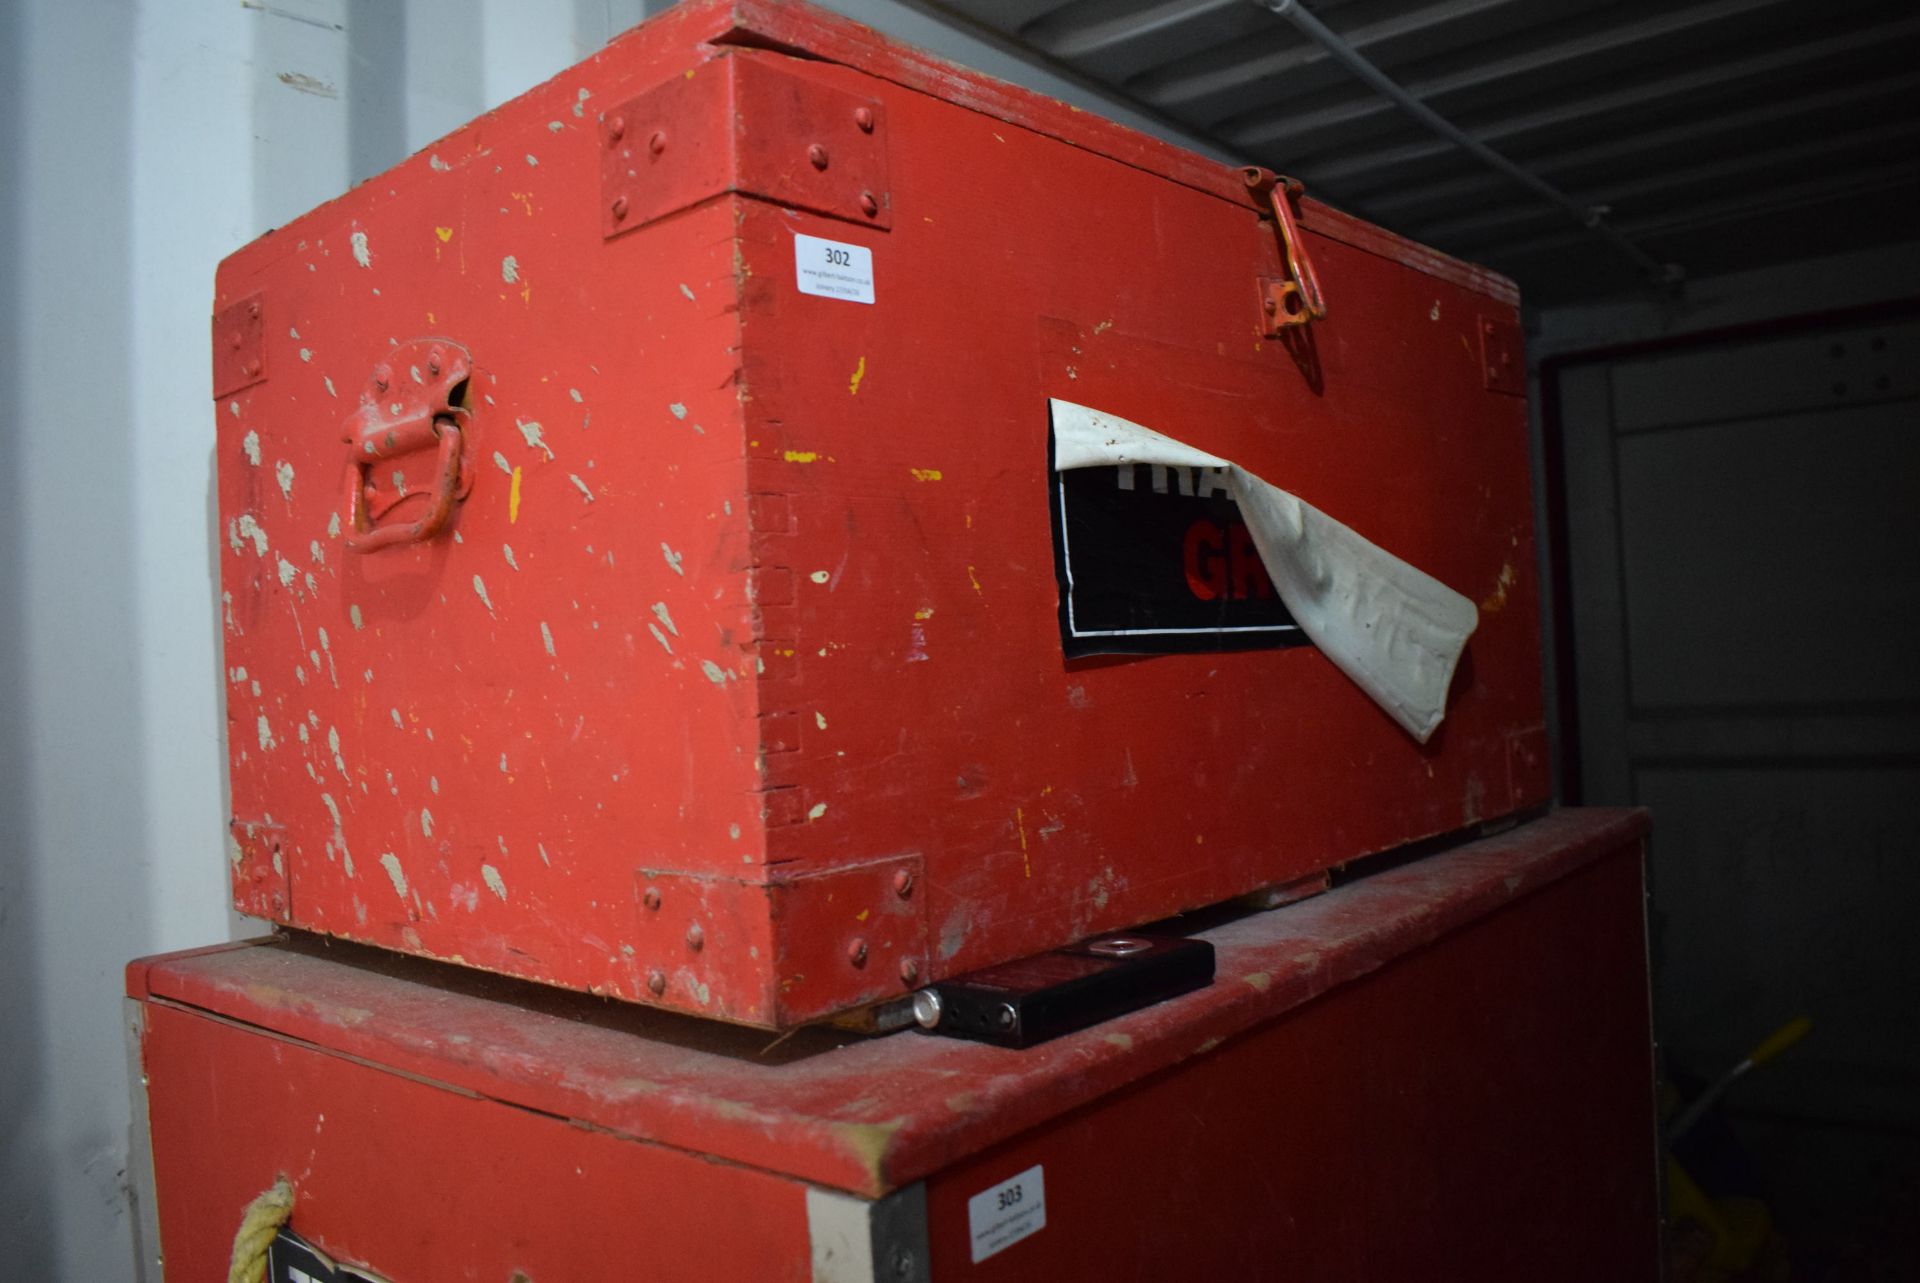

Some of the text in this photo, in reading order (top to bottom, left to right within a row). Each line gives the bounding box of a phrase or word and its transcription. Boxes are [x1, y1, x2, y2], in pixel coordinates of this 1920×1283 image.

[825, 248, 851, 267] 302
[1183, 518, 1273, 601] GR
[998, 1184, 1022, 1211] 303
